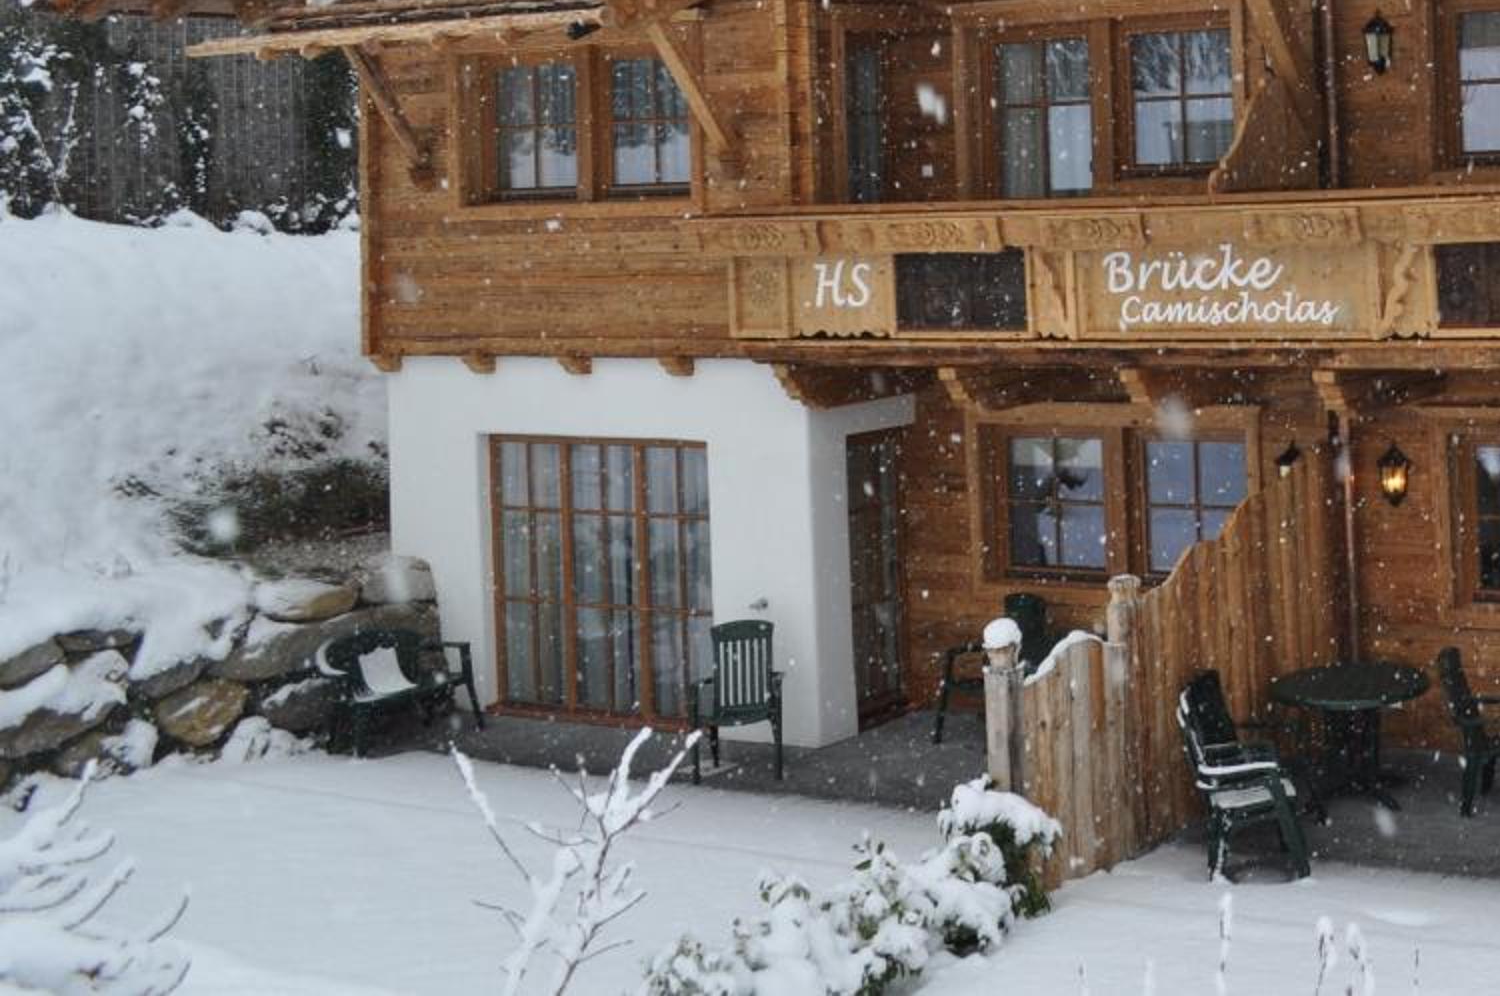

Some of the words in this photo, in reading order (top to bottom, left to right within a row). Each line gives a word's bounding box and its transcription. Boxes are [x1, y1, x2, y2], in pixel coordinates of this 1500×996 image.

[814, 259, 871, 308] HS
[1103, 243, 1284, 293] Brücke
[1120, 291, 1340, 326] Camischolas
